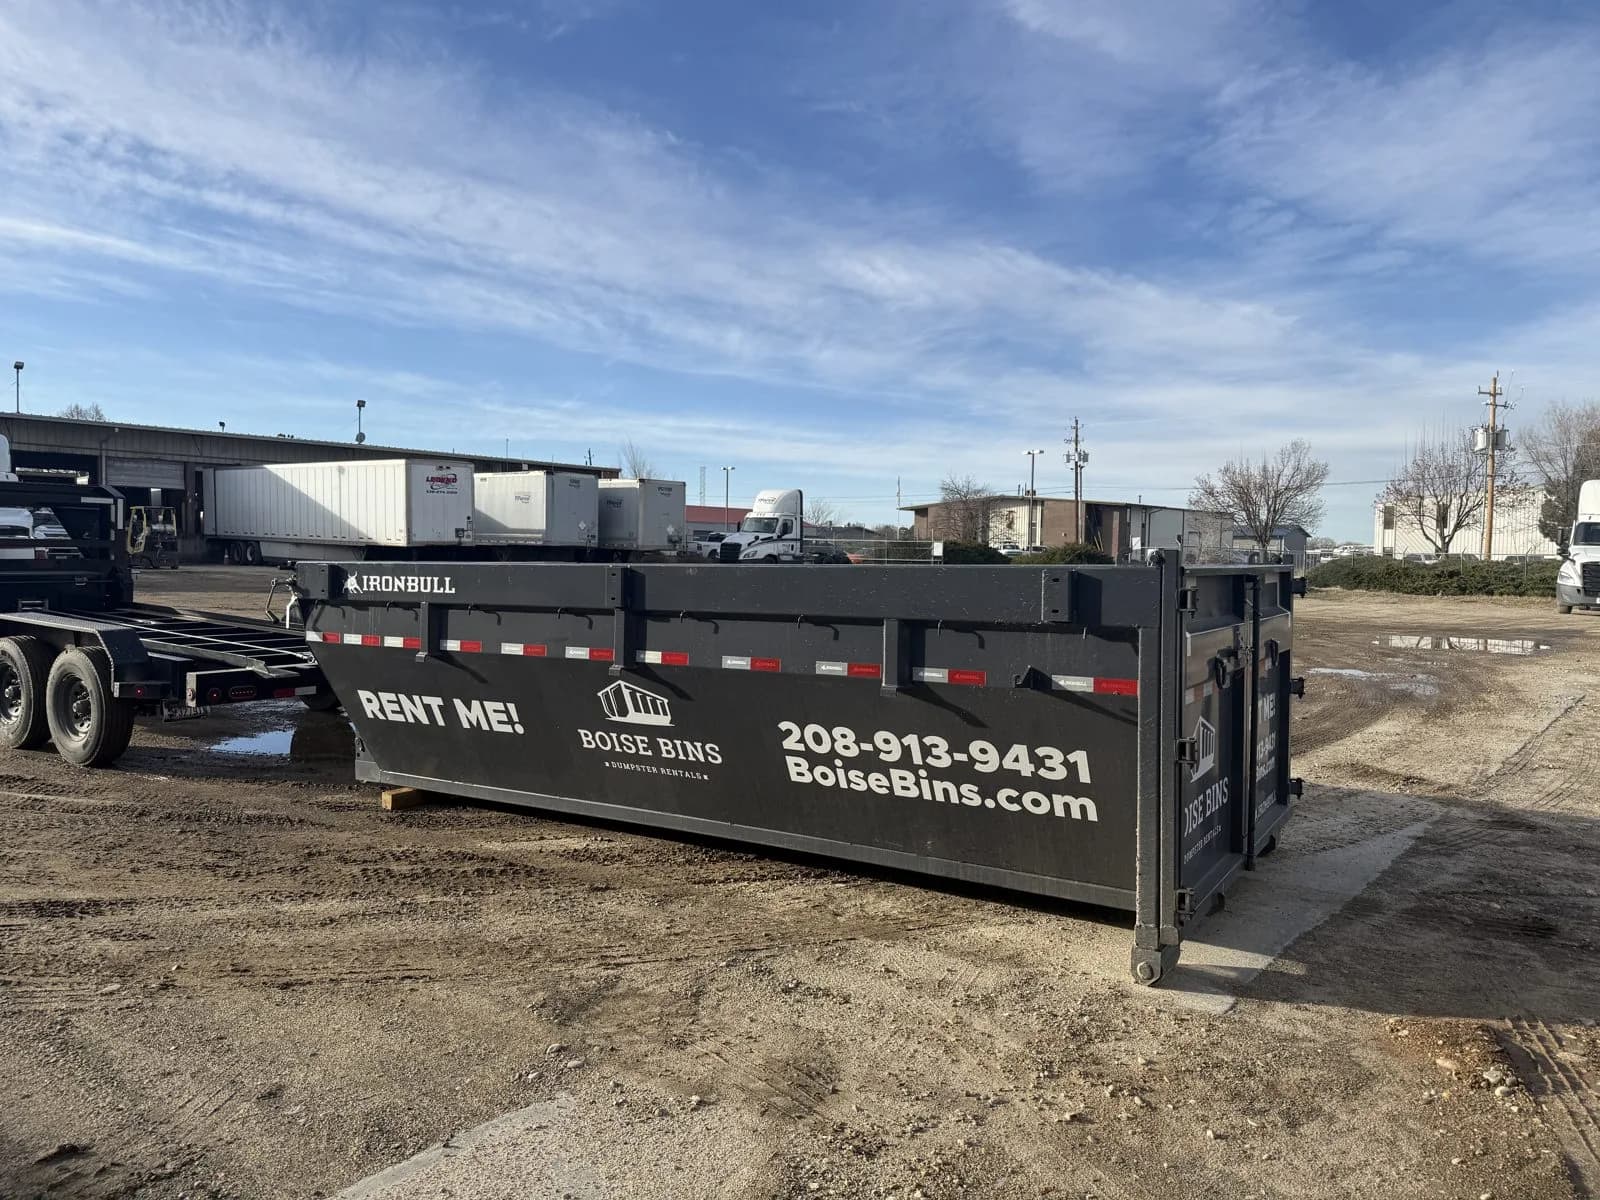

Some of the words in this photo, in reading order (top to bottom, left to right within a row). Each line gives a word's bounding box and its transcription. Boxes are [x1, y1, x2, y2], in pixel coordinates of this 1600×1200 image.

[362, 576, 456, 594] IRONBULL
[357, 689, 445, 727] RENT
[453, 698, 525, 735] ME!
[578, 728, 653, 756] BOISE
[656, 737, 723, 764] BINS
[777, 720, 1092, 784] 208-913-9431
[611, 761, 658, 774] DUMPSTER
[660, 768, 702, 780] RENTALS
[785, 755, 1098, 822] BoiseBins.com
[1205, 776, 1229, 818] BINS
